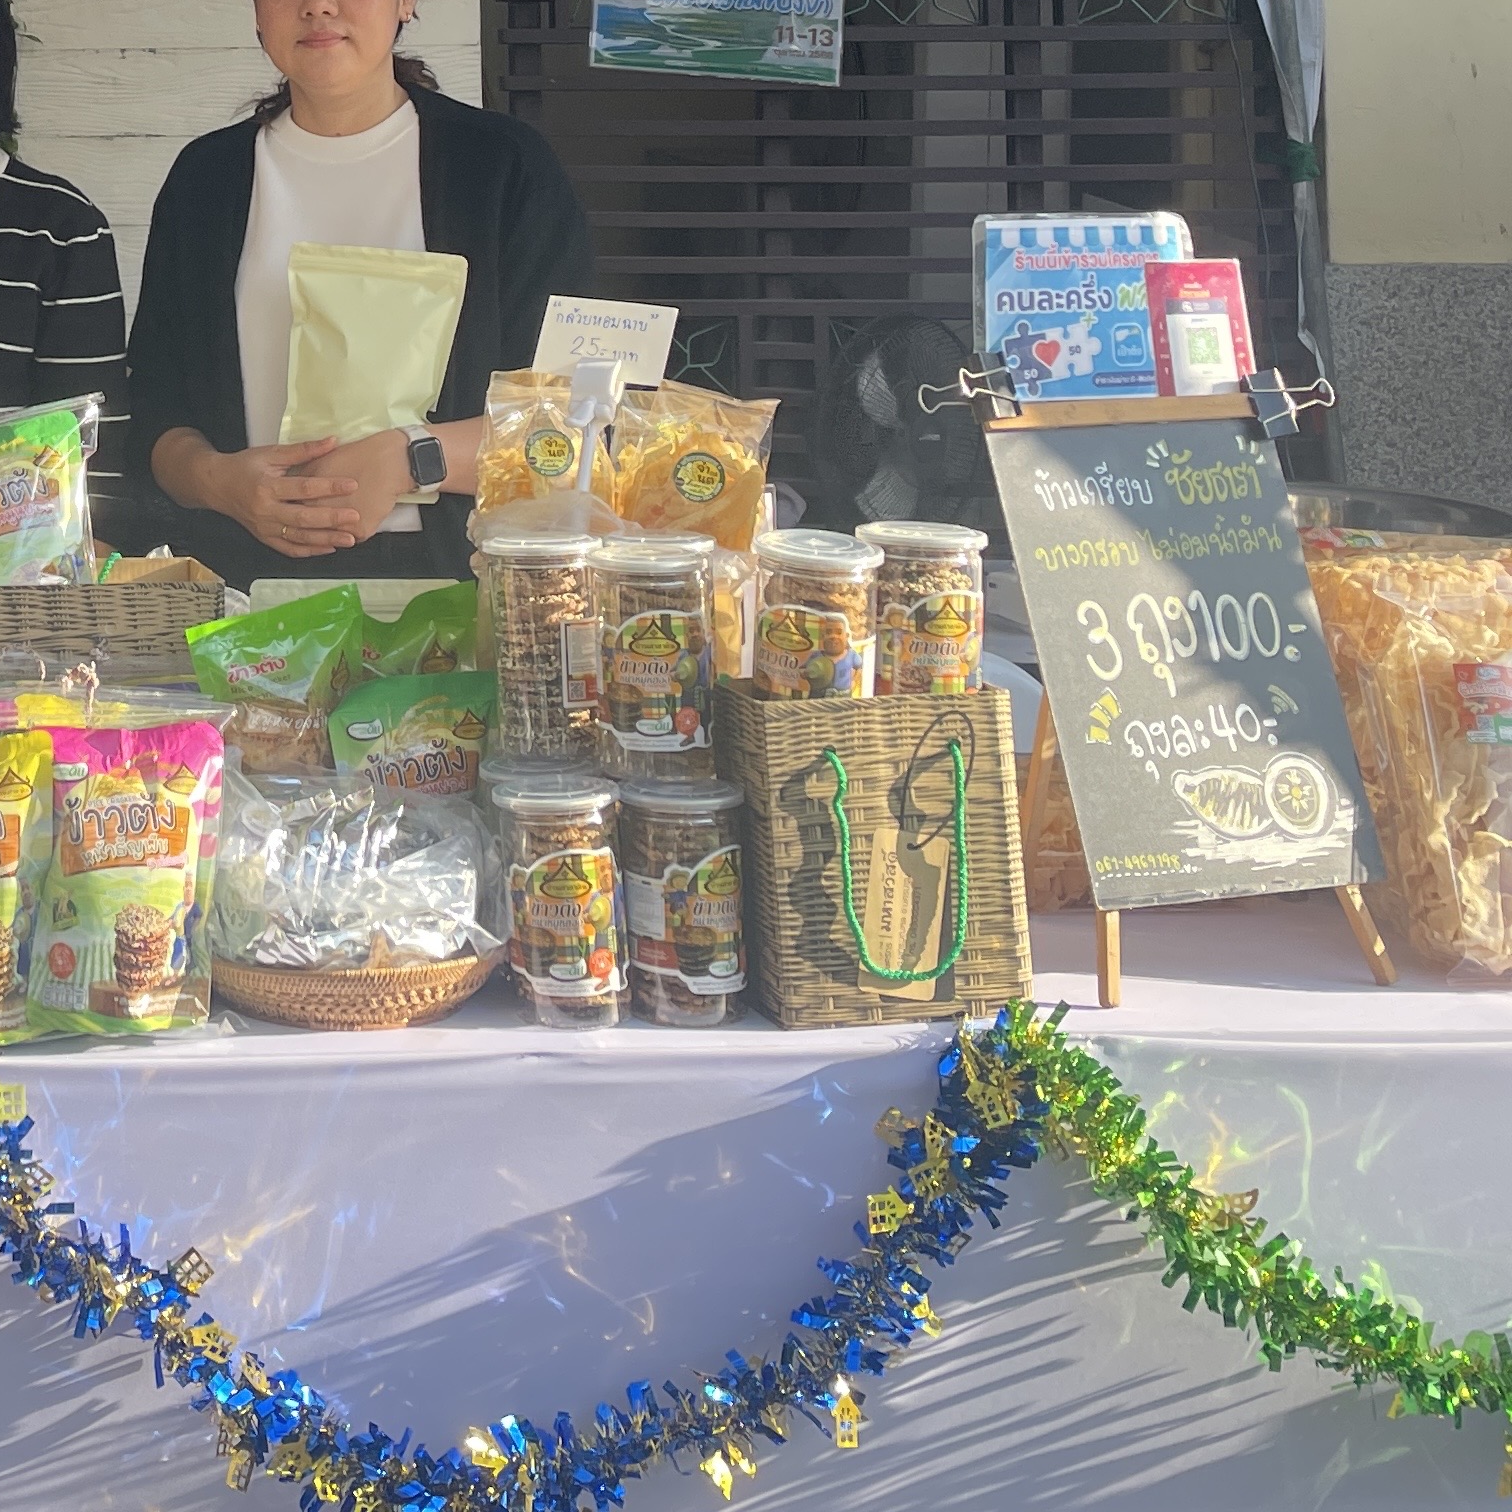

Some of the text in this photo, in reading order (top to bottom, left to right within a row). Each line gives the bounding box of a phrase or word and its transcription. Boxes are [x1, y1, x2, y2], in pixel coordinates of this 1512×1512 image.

[774, 24, 834, 47] 11-13
[996, 272, 1113, 312] คนละครึ่ง
[1068, 344, 1082, 356] 50
[1024, 368, 1038, 379] 50
[1034, 461, 1154, 511] ข้าวเกรียบ
[1034, 538, 1140, 572] บางกรอบ
[1077, 600, 1123, 681] 3
[227, 654, 287, 685] ข้าวตัง
[65, 792, 177, 846] ข้าวตัง
